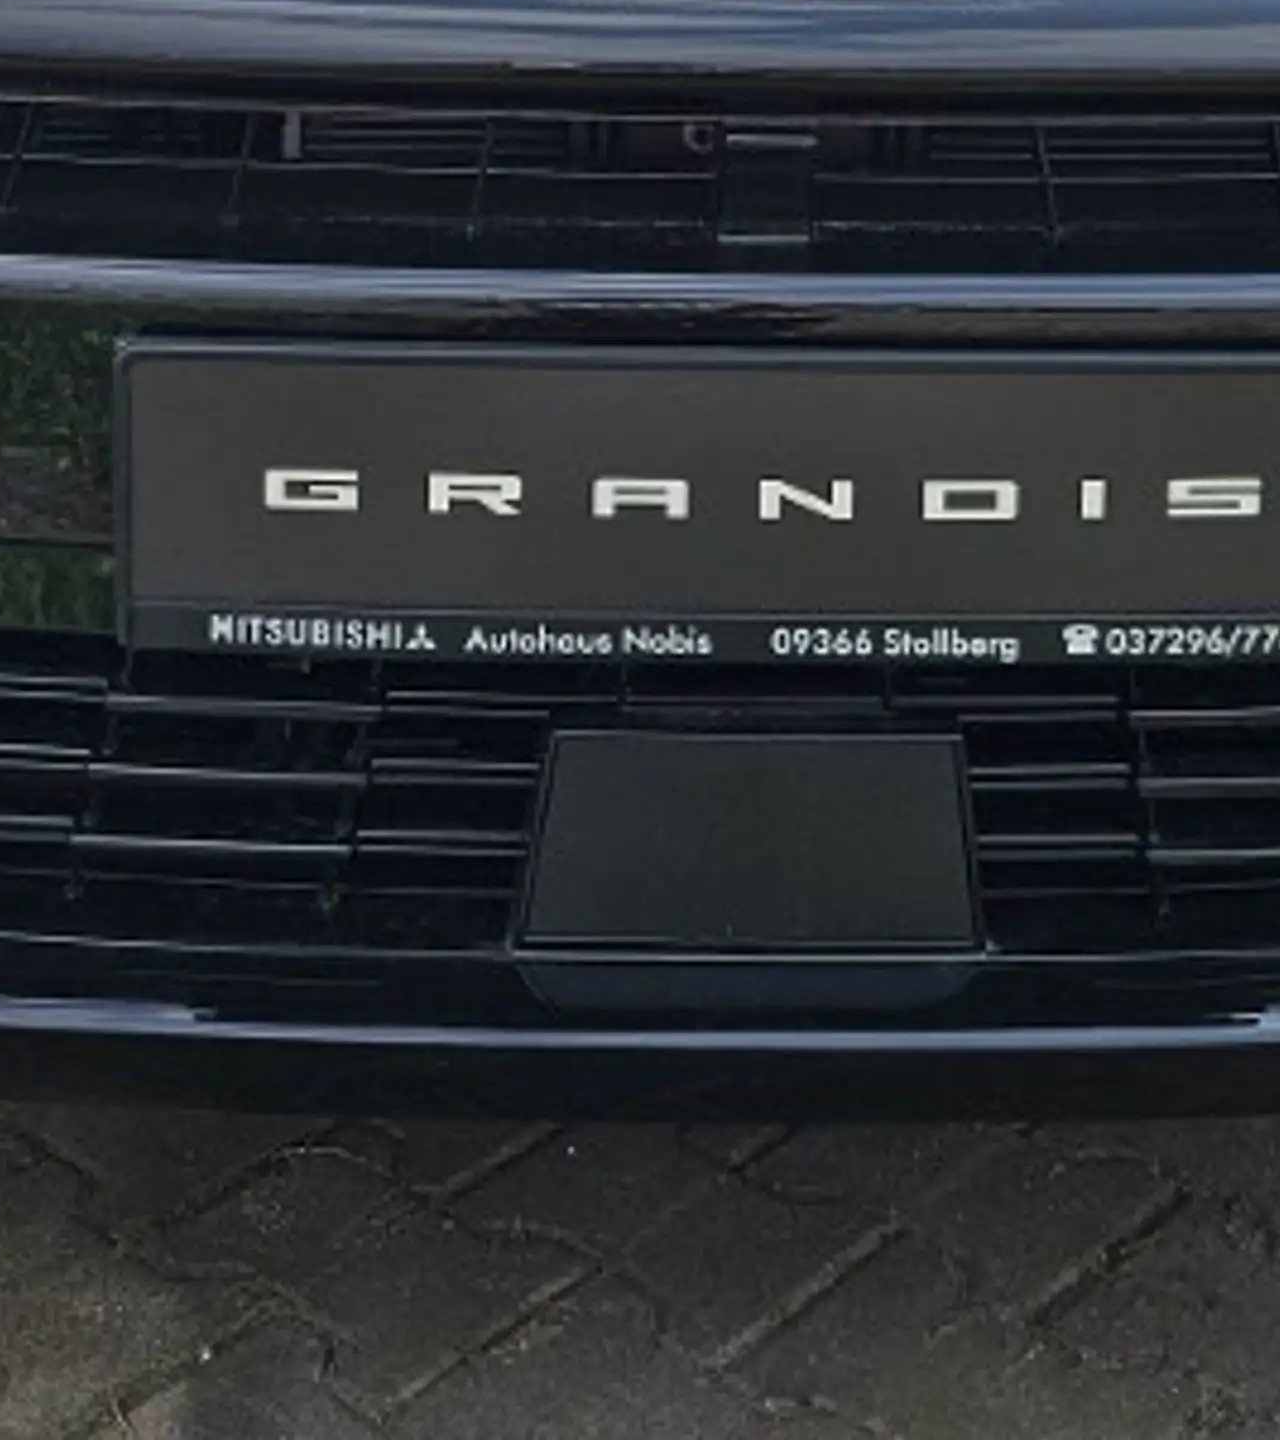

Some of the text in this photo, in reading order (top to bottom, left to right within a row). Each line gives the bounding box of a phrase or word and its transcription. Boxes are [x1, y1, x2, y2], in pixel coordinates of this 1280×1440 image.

[263, 468, 1262, 520] GRANDIS
[209, 613, 403, 650] MITSUBISHI
[464, 624, 613, 655] Autohaus
[622, 624, 713, 656] Nobis
[770, 627, 872, 656] 09366
[883, 626, 1020, 664] Stollberg
